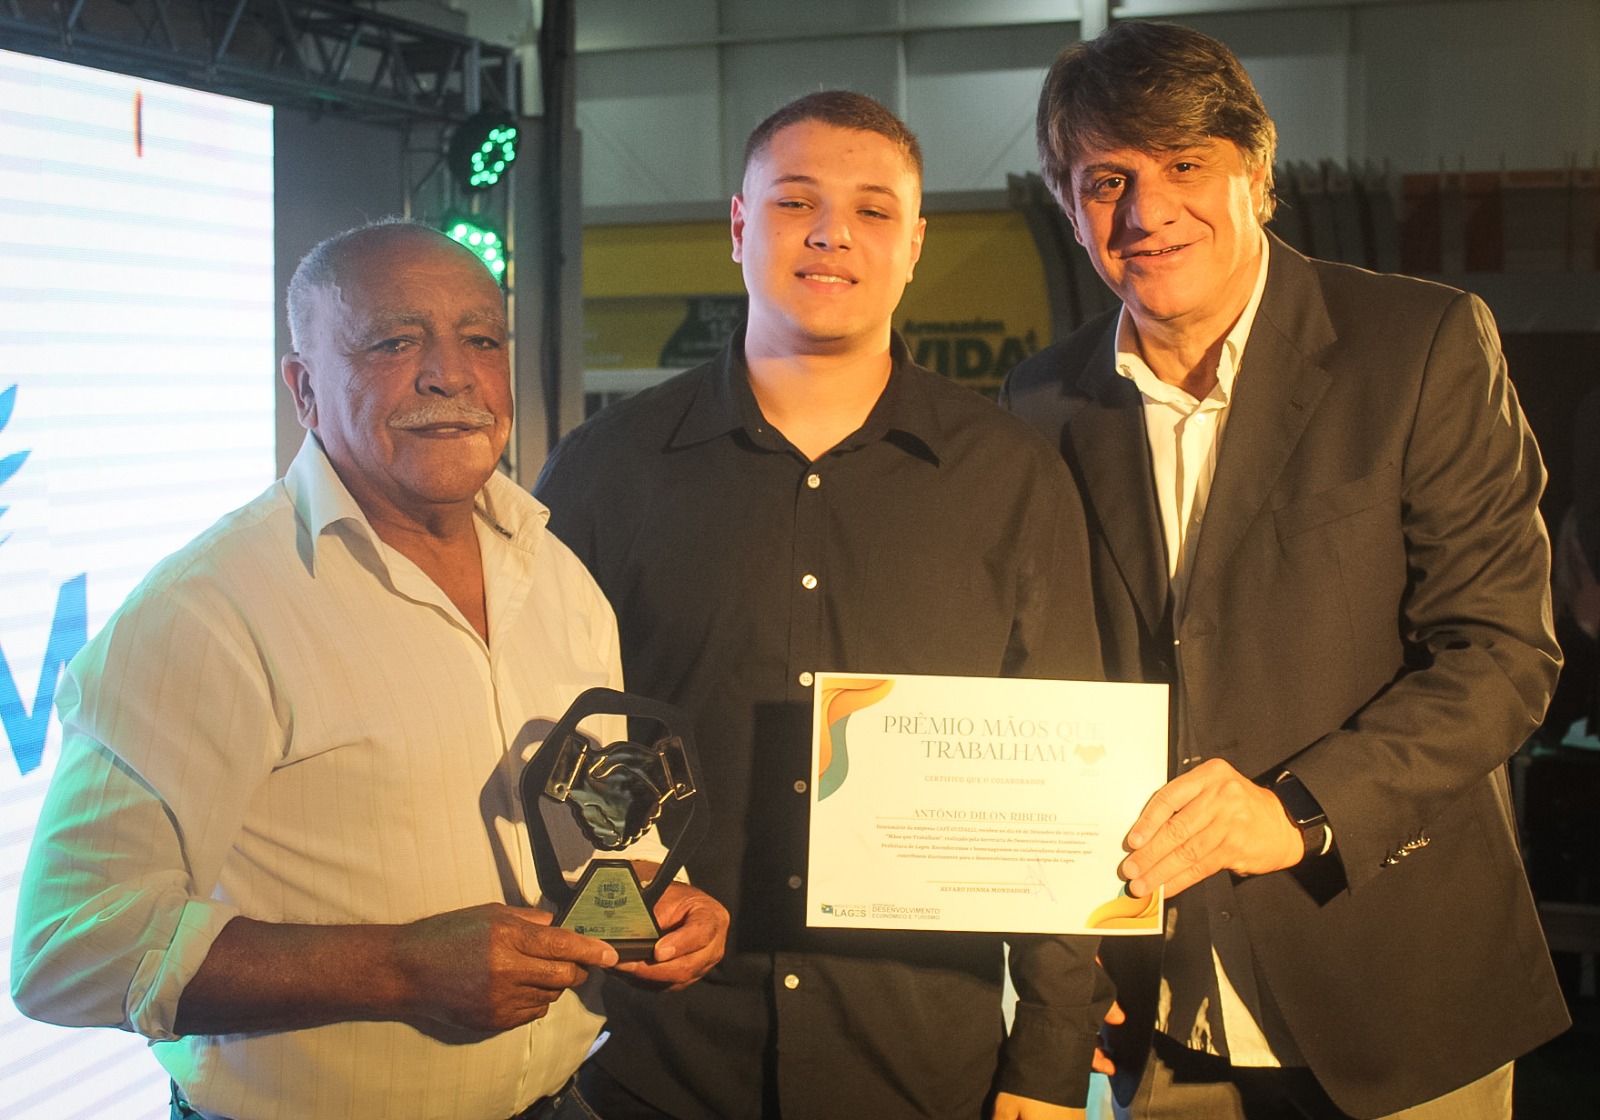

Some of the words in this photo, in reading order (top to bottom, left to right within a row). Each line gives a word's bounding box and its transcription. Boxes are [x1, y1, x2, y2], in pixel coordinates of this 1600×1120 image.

[884, 712, 974, 736] PRÊMIO
[981, 716, 1049, 738] MÃOS
[1055, 720, 1106, 743] QUE
[921, 740, 1066, 762] TRABALHAM
[913, 807, 967, 819] ANTÔNIO
[1010, 813, 1058, 823] RIBEIRO
[834, 908, 867, 918] LAGES
[872, 906, 940, 915] DESENVOLVIMENTO
